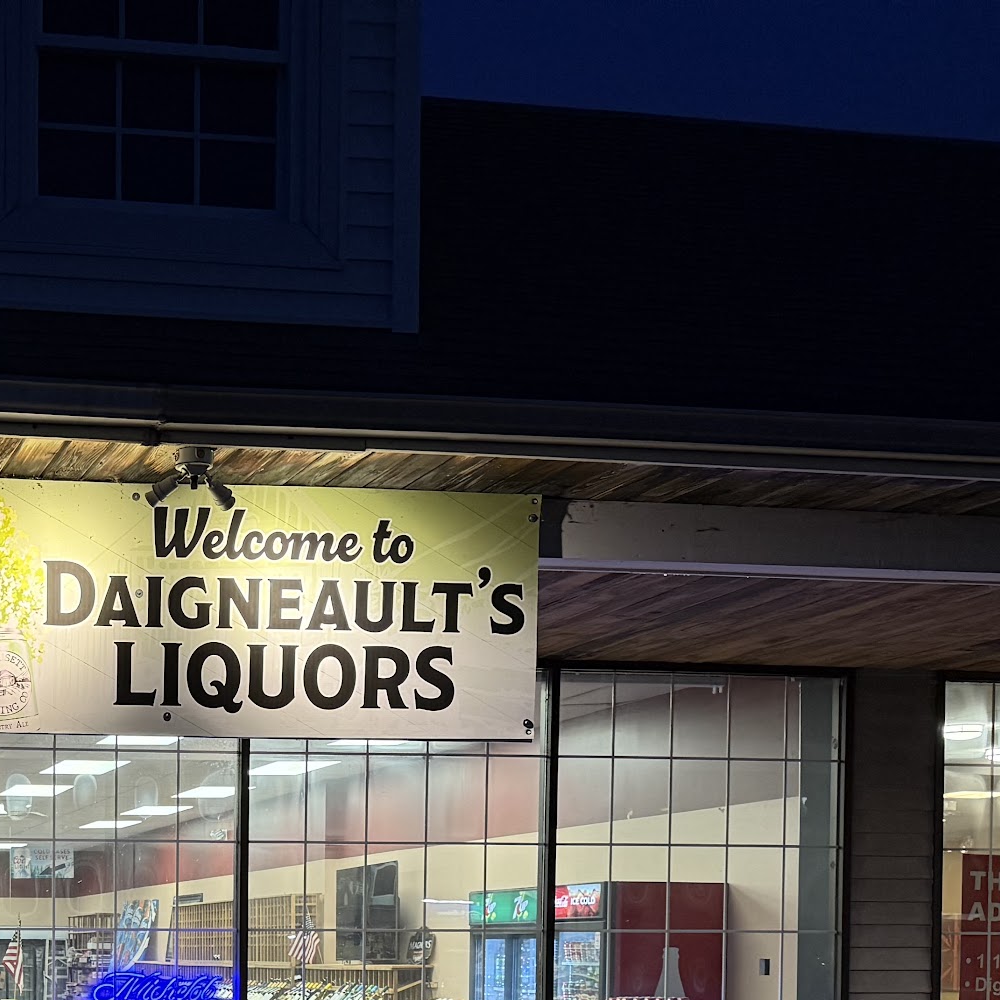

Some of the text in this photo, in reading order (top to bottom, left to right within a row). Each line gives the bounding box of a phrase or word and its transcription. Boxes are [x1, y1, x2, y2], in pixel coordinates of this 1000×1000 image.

[153, 506, 415, 564] Welcome to
[42, 560, 526, 635] DAIGNEAULT'S
[113, 641, 456, 714] LIQUORS
